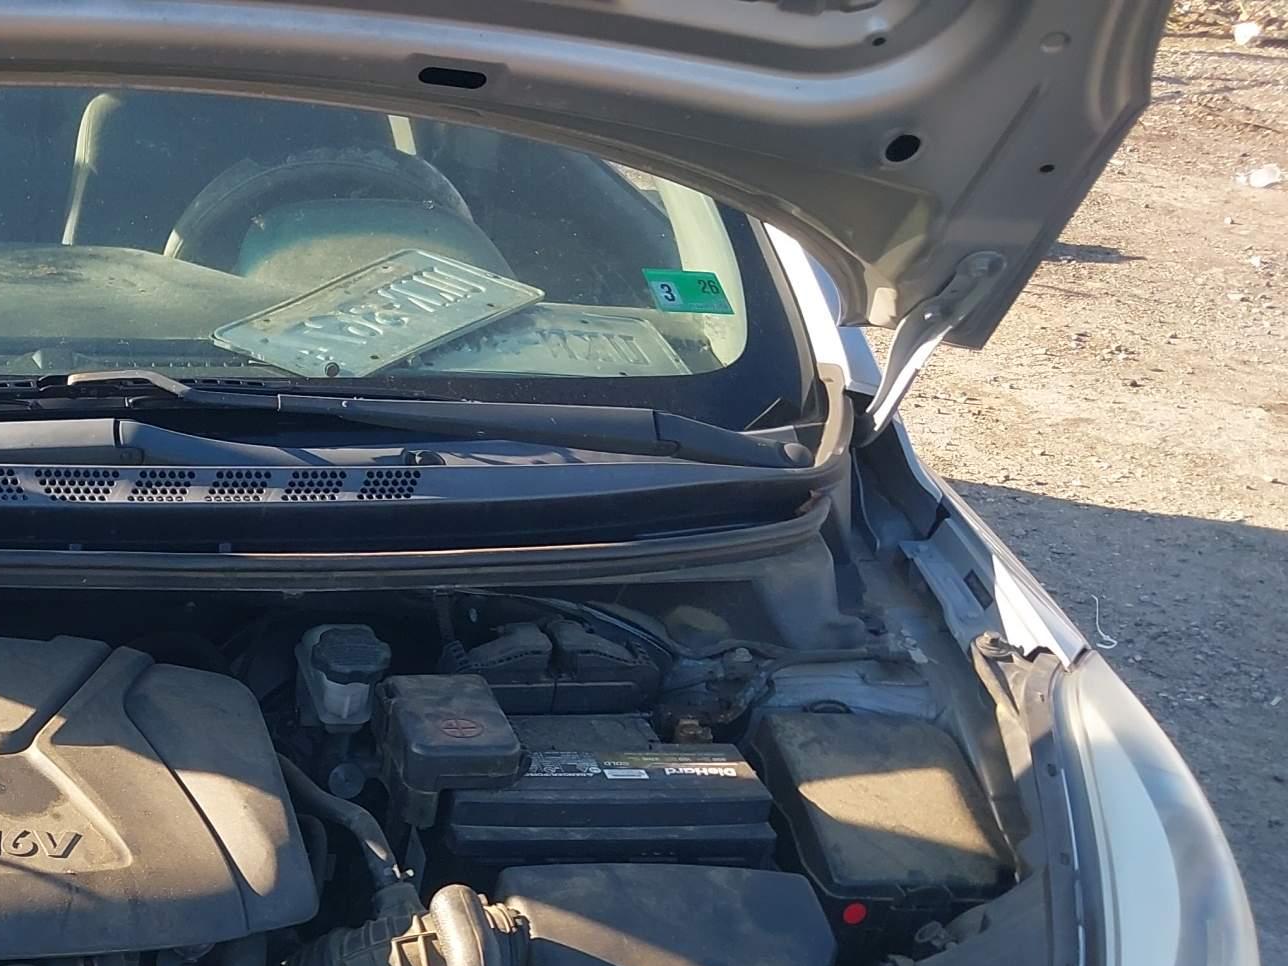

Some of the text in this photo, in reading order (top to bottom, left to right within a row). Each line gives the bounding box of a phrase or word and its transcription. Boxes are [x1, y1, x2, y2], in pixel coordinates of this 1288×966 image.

[660, 280, 720, 302] 3 26
[664, 767, 736, 777] DieHard
